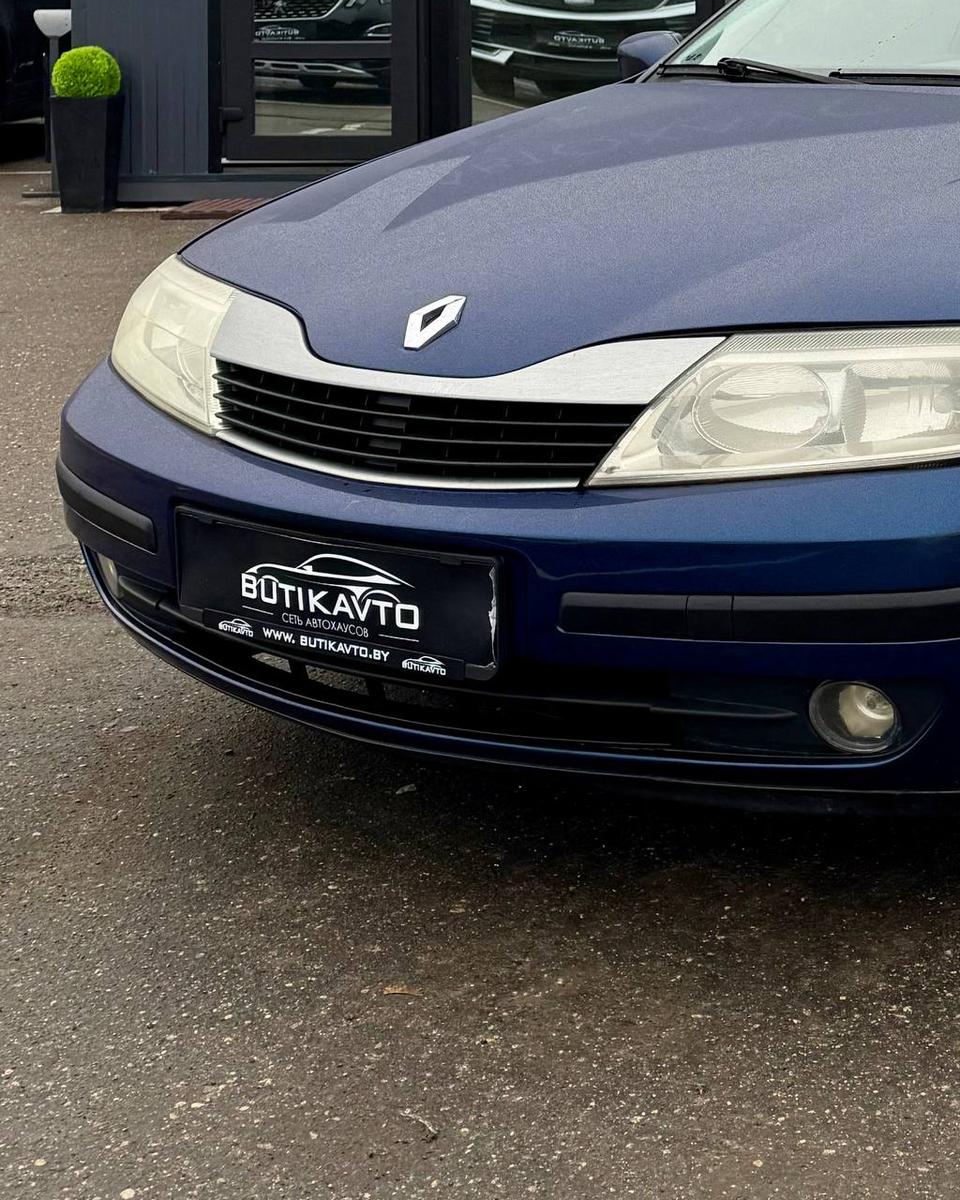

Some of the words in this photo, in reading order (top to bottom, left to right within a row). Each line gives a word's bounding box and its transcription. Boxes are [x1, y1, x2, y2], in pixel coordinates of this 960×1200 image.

[241, 572, 420, 630] BUTIKAVTO
[218, 622, 254, 638] BUTIKAVTO
[281, 612, 304, 626] СЕТЬ
[305, 616, 369, 638] АВТОХАУСОВ
[262, 626, 296, 645] WWW.
[299, 635, 391, 662] BUTIKAVTO.BY
[401, 660, 447, 676] BUTIKAVTO
